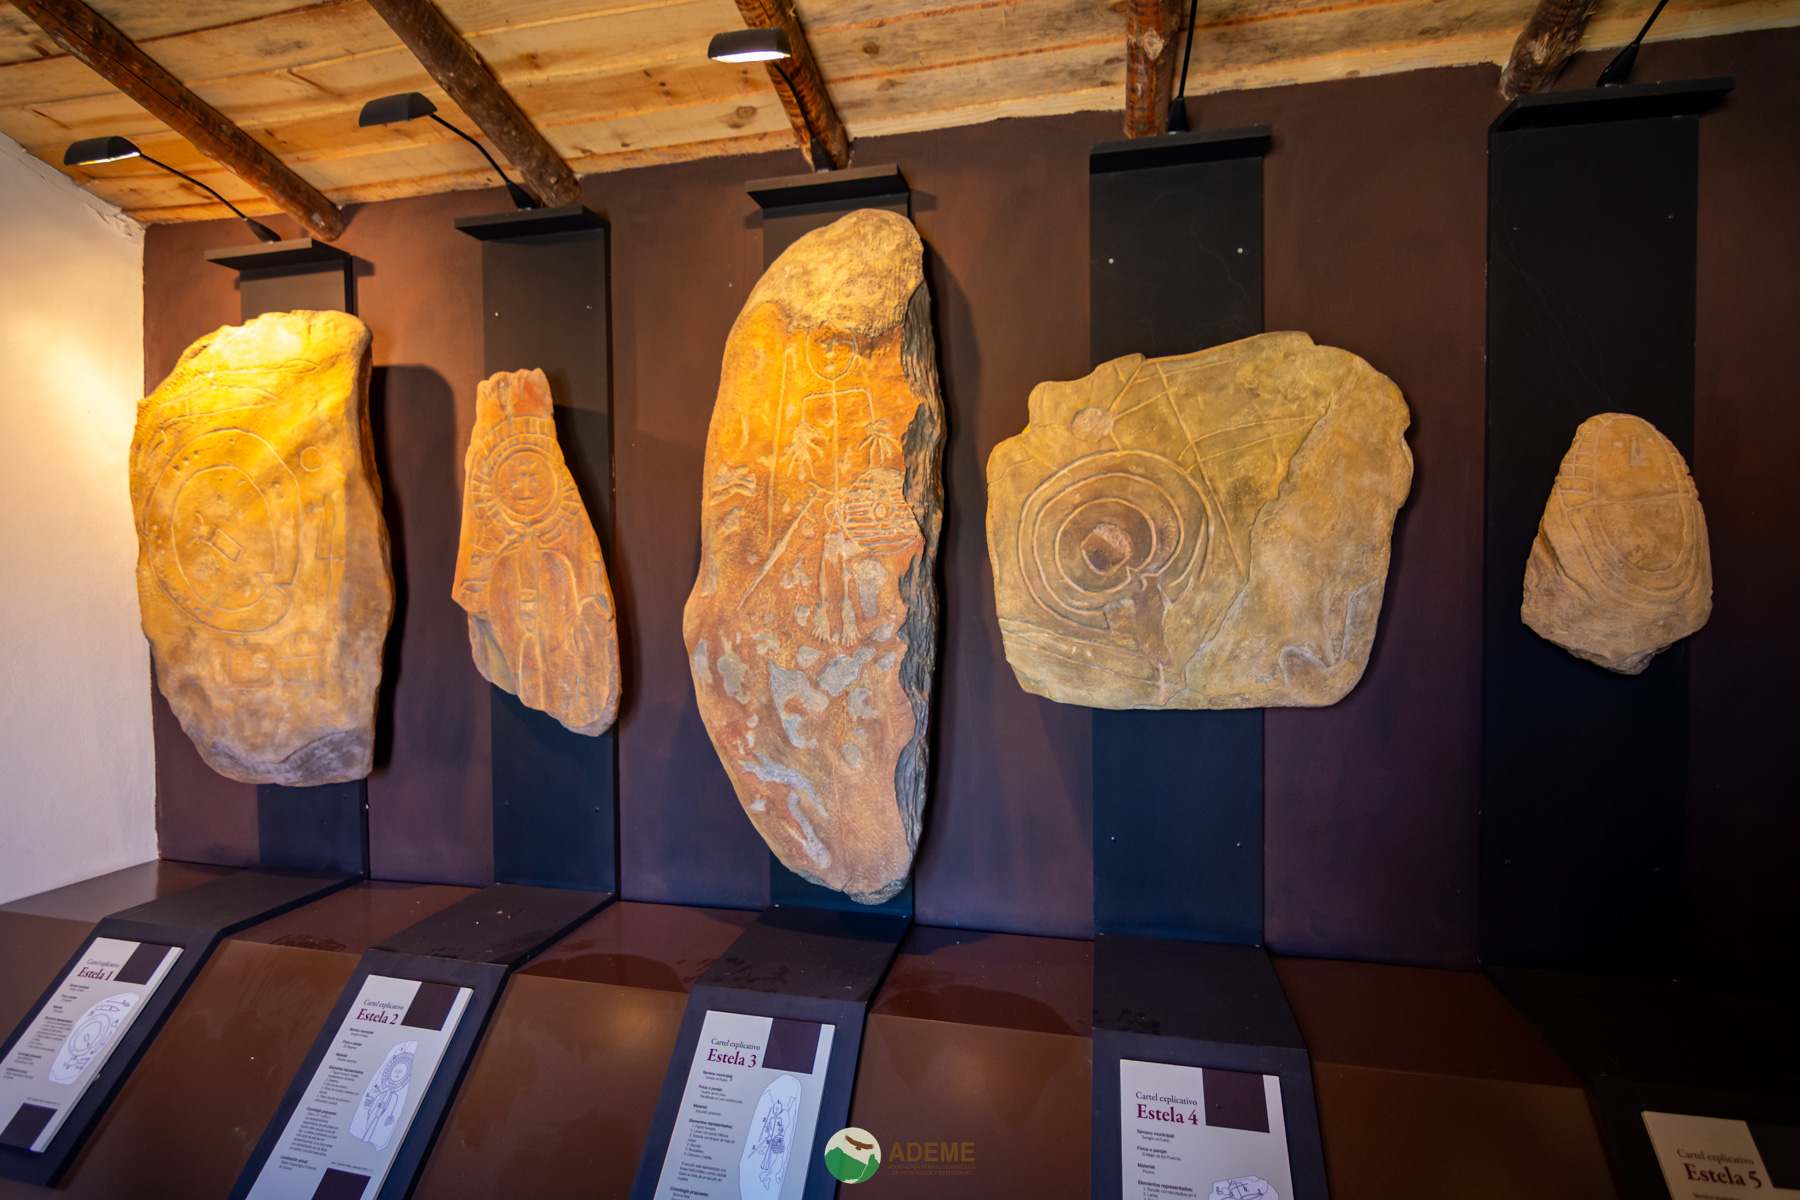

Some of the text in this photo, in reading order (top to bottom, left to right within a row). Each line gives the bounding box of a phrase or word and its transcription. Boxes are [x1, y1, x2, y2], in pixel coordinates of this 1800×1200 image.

[78, 966, 114, 980] Estela 1
[364, 999, 379, 1007] Cartel
[356, 1008, 398, 1025] Estela 2
[711, 1038, 761, 1050] Cartel explicativo
[706, 1048, 757, 1068] Estela 3
[1136, 1091, 1198, 1106] Cartel explicativo
[1136, 1103, 1198, 1125] Estela 4
[1677, 1149, 1755, 1165] Cartel explicativo
[1683, 1162, 1762, 1188] Estela 5
